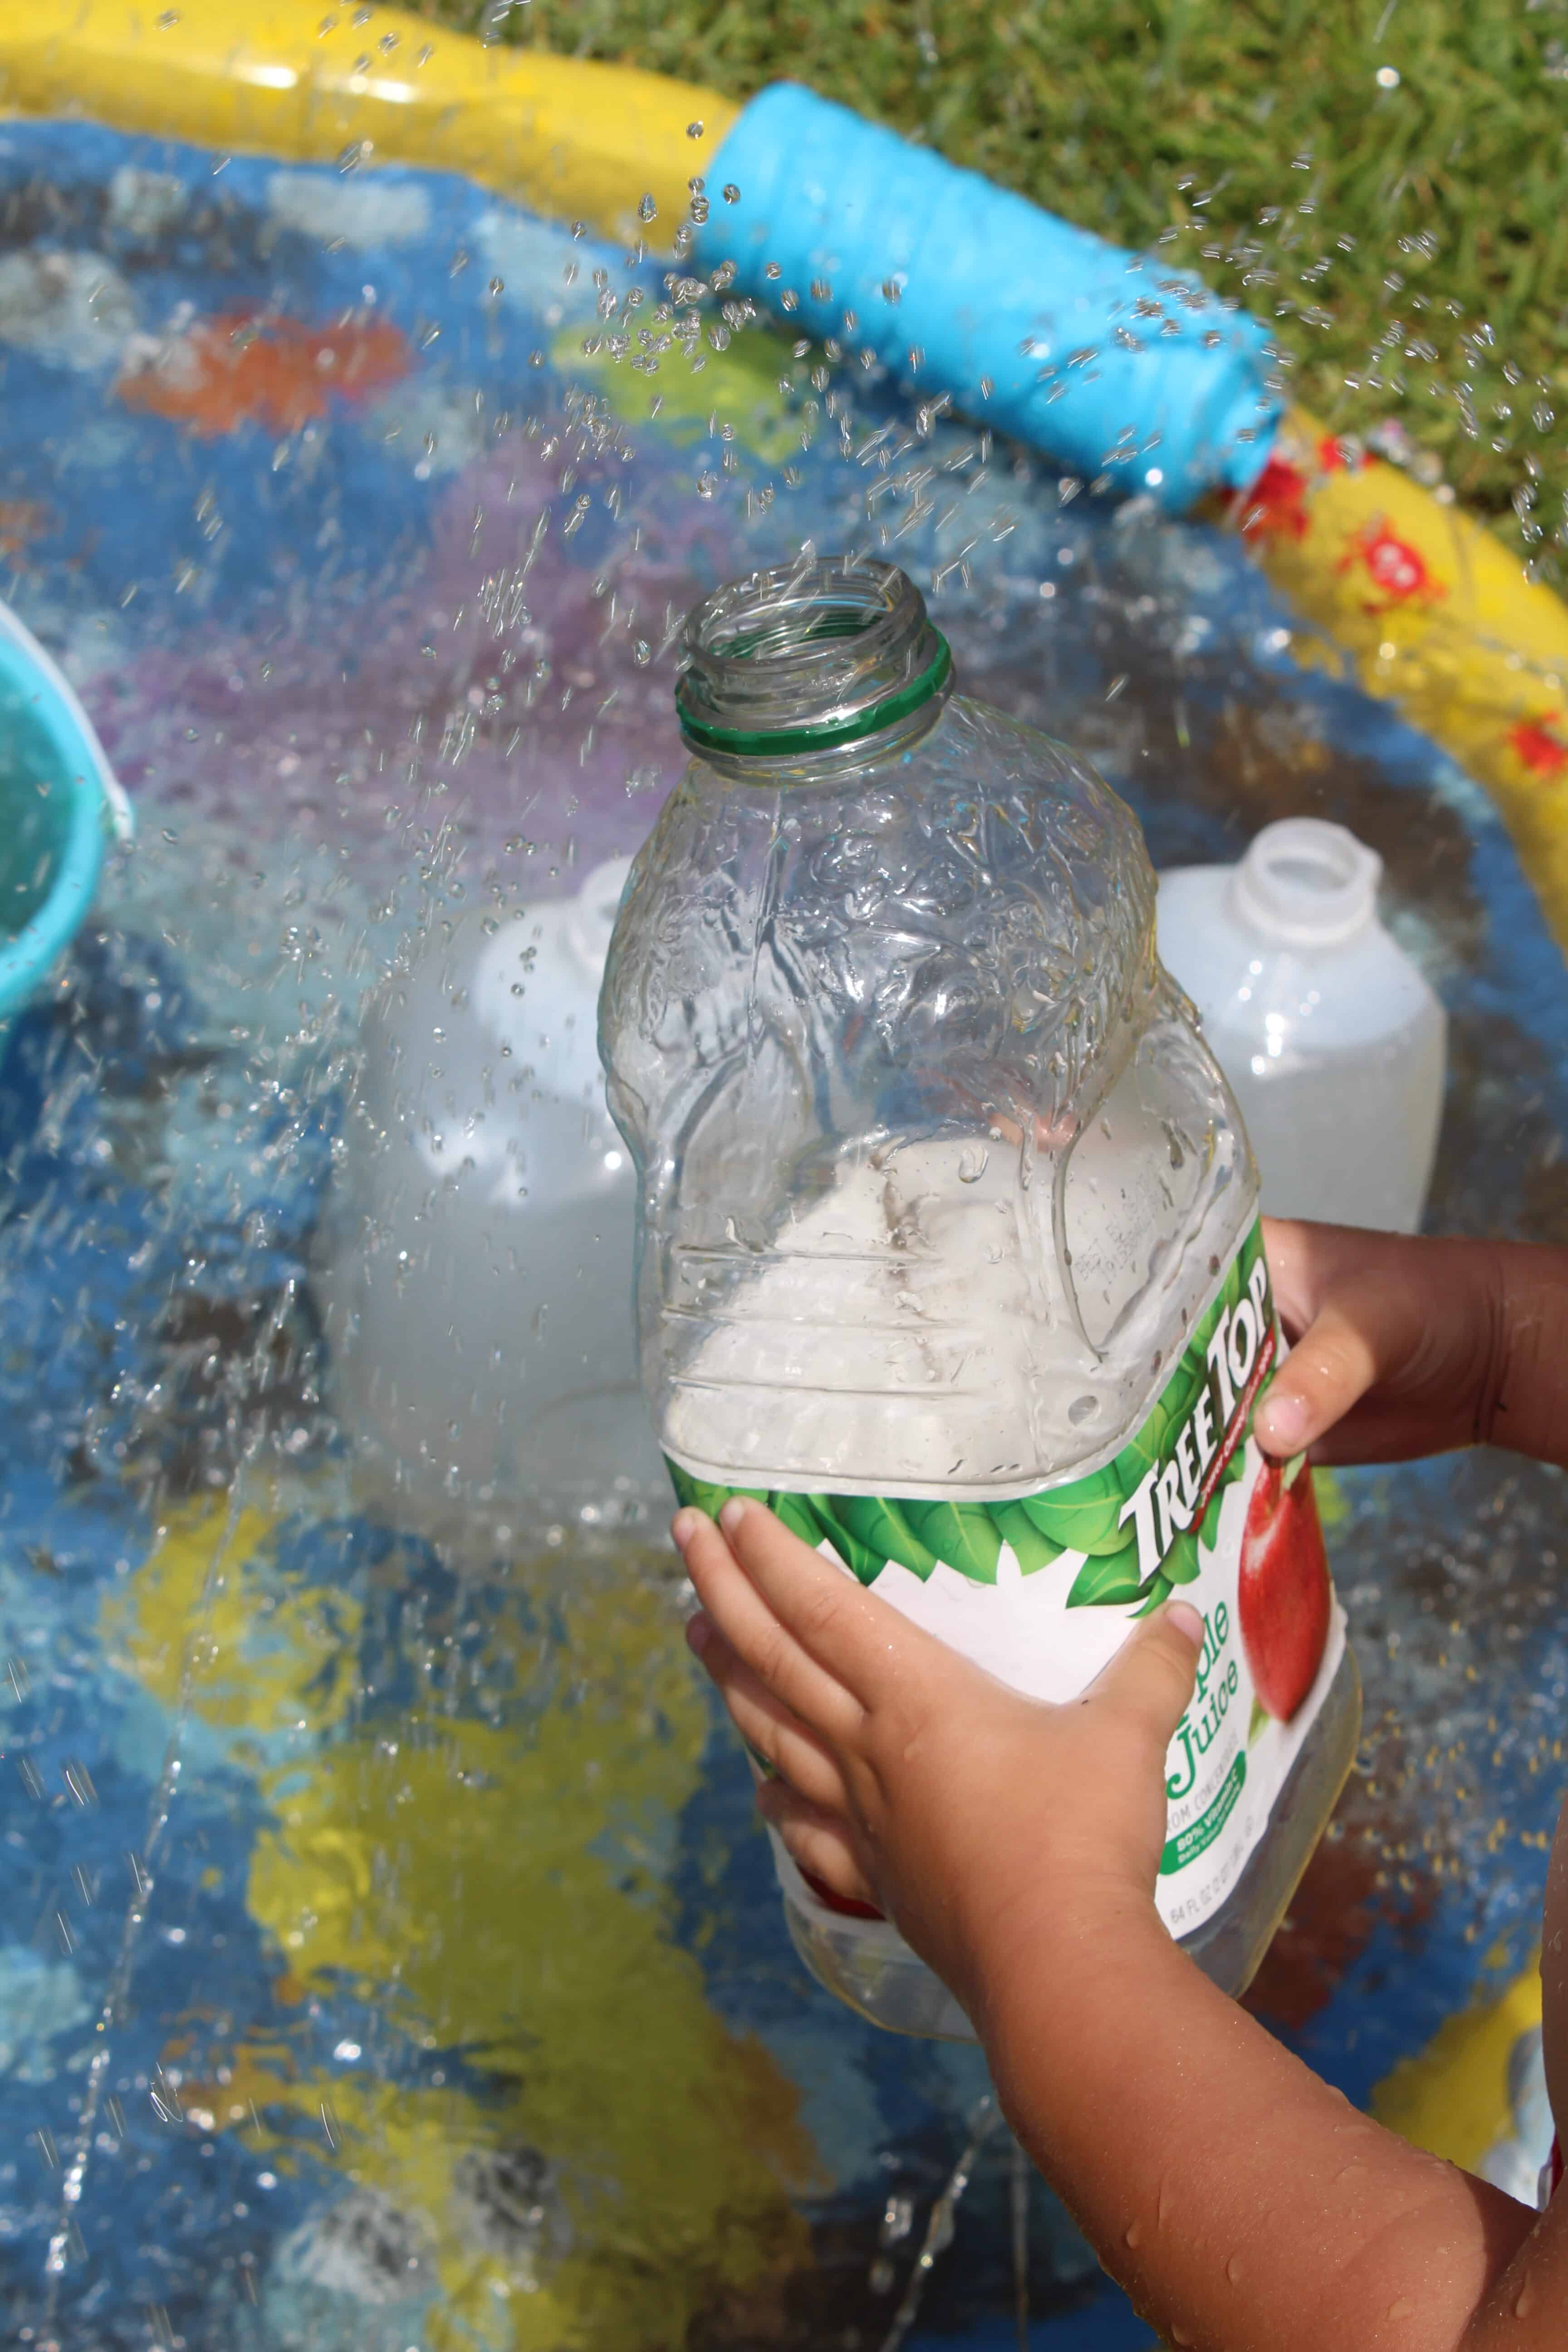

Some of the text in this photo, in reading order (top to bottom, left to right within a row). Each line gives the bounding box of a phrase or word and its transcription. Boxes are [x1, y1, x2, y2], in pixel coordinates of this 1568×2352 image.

[1118, 1256, 1267, 1587] TREE TOP
[1166, 1659, 1238, 1800] Juice
[1167, 1804, 1191, 1832] OM
[1176, 1823, 1205, 1852] 80%
[1170, 1905, 1186, 1924] 64
